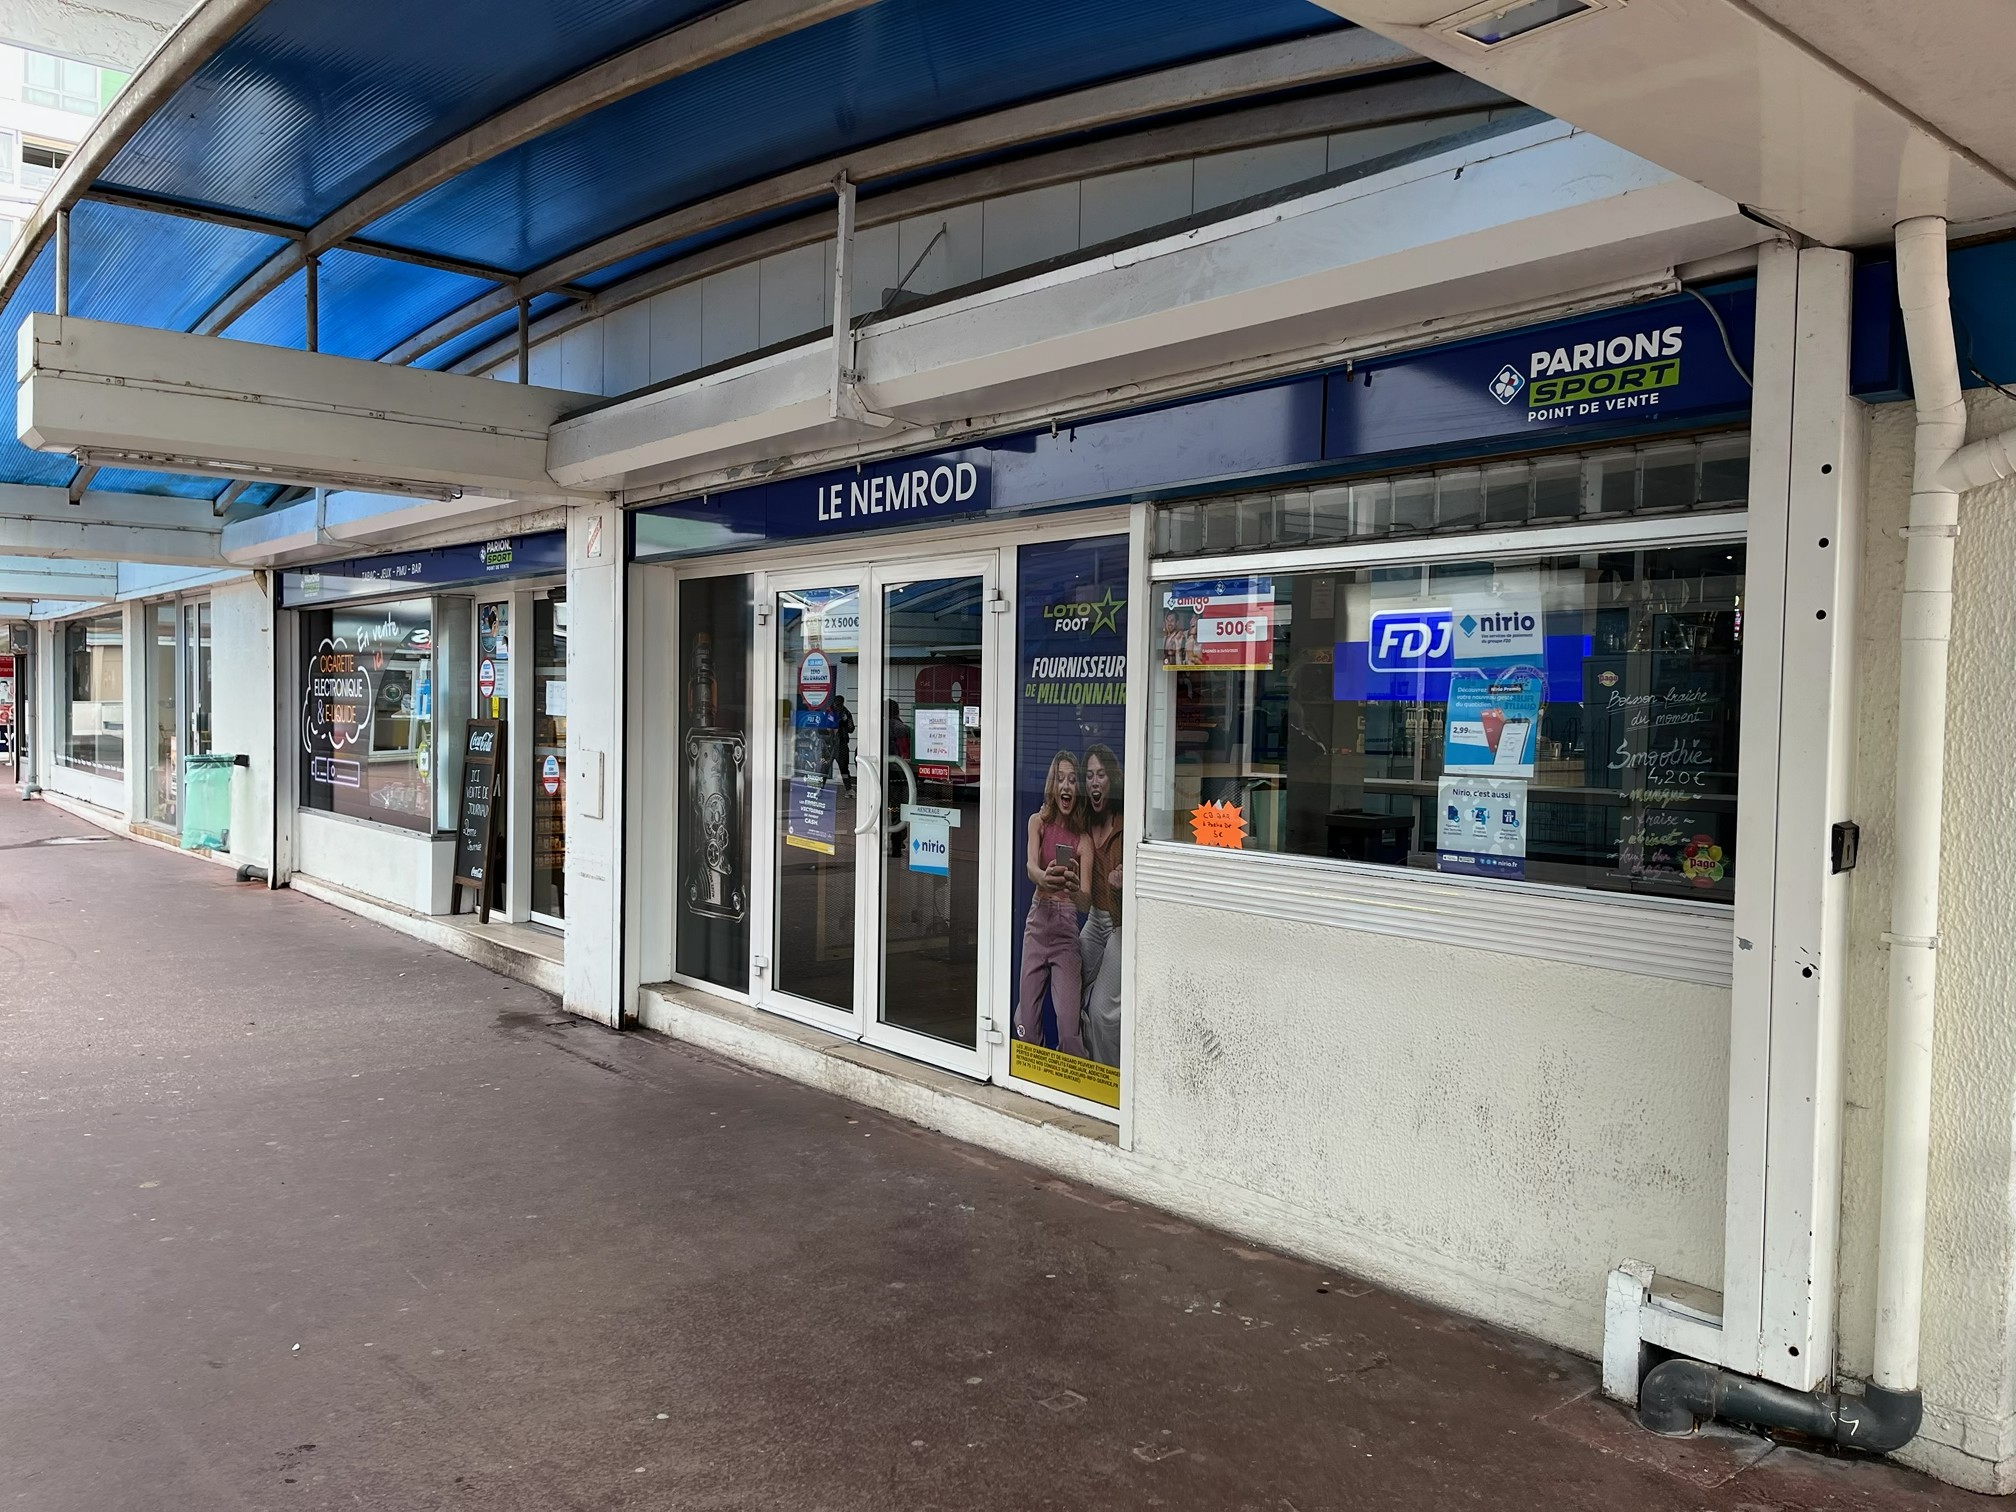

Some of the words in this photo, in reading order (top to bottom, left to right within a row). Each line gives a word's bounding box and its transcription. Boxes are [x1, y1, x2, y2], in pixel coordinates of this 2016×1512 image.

[1530, 326, 1683, 378] PARIONS
[1533, 362, 1676, 403] SPORT
[1527, 405, 1574, 422] POINT
[1579, 401, 1599, 415] DE
[1605, 392, 1660, 411] VENTE
[818, 483, 843, 521] LE
[850, 462, 977, 517] NEMROD
[487, 552, 512, 564] SPORT
[380, 568, 392, 579] JEUX
[396, 564, 408, 576] PMU
[411, 562, 422, 574] BAR
[1043, 603, 1091, 618] LOTO
[824, 618, 830, 628] 2
[838, 616, 859, 628] 500€
[1055, 617, 1089, 632] FOOT
[1216, 620, 1256, 636] 500€
[1481, 611, 1535, 632] nirio
[356, 625, 370, 652] En
[372, 611, 399, 641] vente
[1378, 621, 1453, 659] FDJ
[320, 654, 354, 672] CIGARETTE
[1031, 655, 1126, 678] FOURNISSEUR
[1025, 683, 1036, 697] DE
[1606, 690, 1657, 709] Boisson
[317, 699, 325, 724] &
[325, 704, 356, 724] E-LIQUIDE
[1631, 710, 1650, 726] du
[1656, 707, 1704, 724] moment
[1608, 738, 1712, 770] Smoothie
[1648, 767, 1706, 786] 4,20€
[1452, 788, 1472, 797] Nirio,
[922, 840, 946, 854] nirio
[1689, 858, 1716, 869] pago
